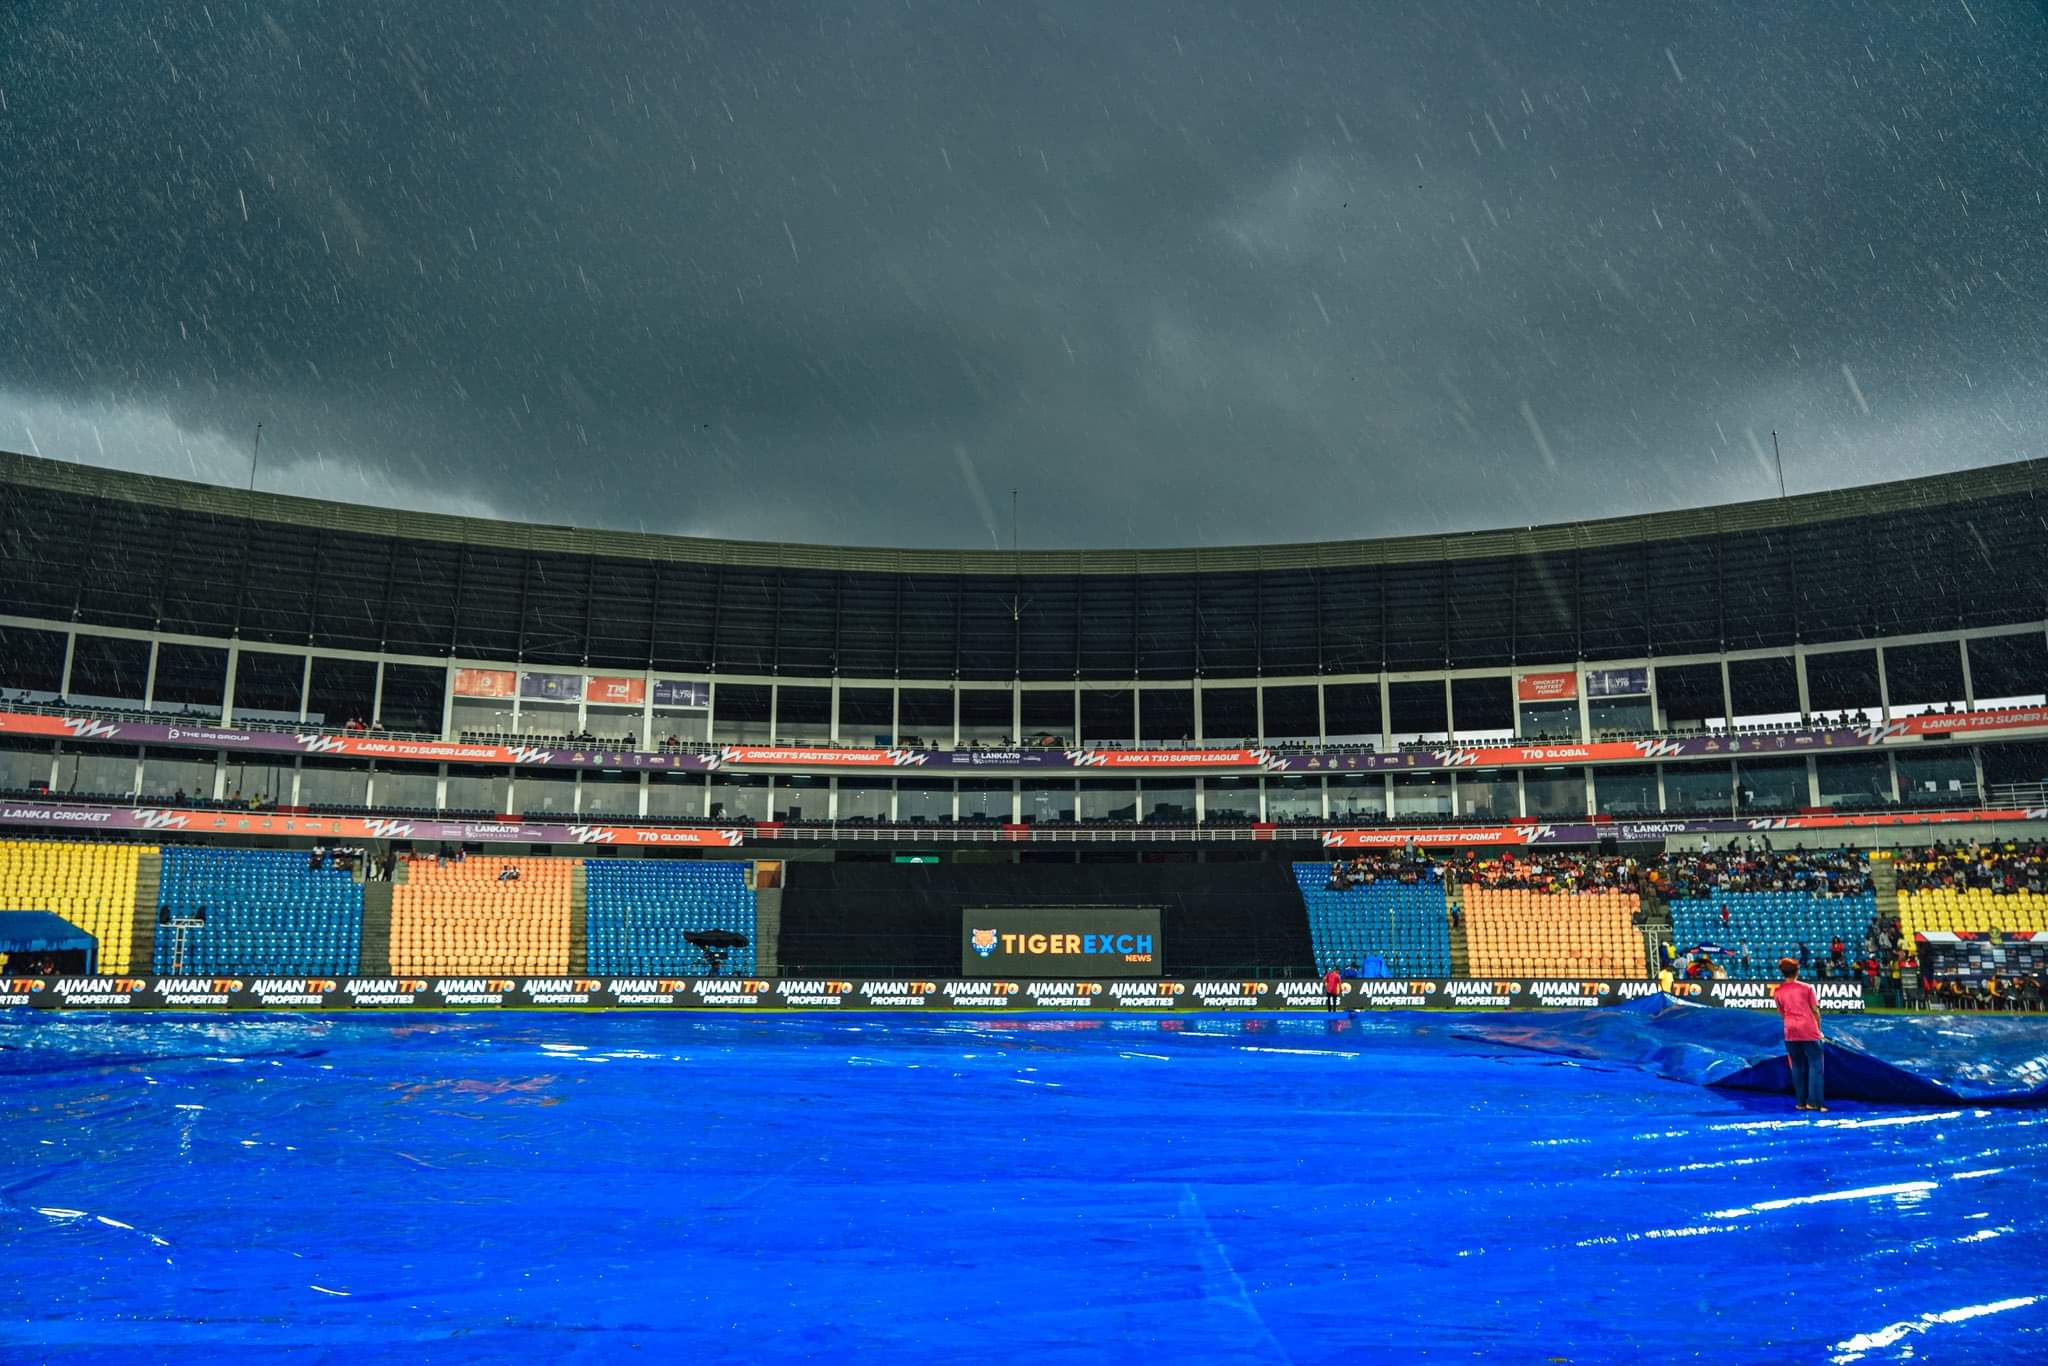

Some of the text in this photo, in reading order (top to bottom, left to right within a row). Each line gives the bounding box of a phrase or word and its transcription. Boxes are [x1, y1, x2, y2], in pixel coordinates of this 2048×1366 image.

[1922, 719, 1966, 728] LANKA
[1970, 717, 1994, 725] T10
[1996, 713, 2040, 723] SUPER
[357, 744, 395, 752] LANKA
[454, 749, 496, 757] LEAGUE
[1522, 749, 1588, 759] T10 GLOBAL
[3, 810, 111, 821] LANKA CRICKET
[637, 832, 658, 841] T10
[1413, 834, 1457, 842] FASTEST
[1002, 934, 1152, 954] TIGEREXCH
[14, 980, 45, 992] T10
[53, 979, 145, 995] AJMAN T10
[154, 980, 243, 996] AJMAN T10
[250, 980, 336, 996] AJMAN T10
[344, 980, 427, 996] AJMAN T10
[435, 980, 515, 996] AJMAN T10
[523, 980, 601, 996] AJMAN T10
[608, 980, 685, 996] AJMAN T10
[693, 981, 769, 997] AJMAN T10
[776, 981, 852, 997] AJMAN T10
[860, 982, 936, 997] AJMAN T10
[943, 983, 1019, 998] AJMAN T10
[1027, 983, 1102, 998] AJMAN T10
[1109, 983, 1184, 998] AJMAN T10
[1193, 983, 1268, 998] AJMAN T10
[1276, 983, 1324, 998] AJMAN
[1360, 982, 1436, 997] AJMAN T10
[1444, 982, 1521, 997] AJMAN T10
[1530, 982, 1609, 997] AJMAN T10
[1673, 983, 1702, 996] T10
[1711, 984, 1765, 999] AJMAN
[1811, 984, 1863, 999] JMAN
[64, 994, 131, 1004] PROPERTIES
[165, 994, 228, 1004] PROPERTIES
[261, 994, 322, 1004] PROPERTIES
[355, 994, 414, 1004] PROPERTIES
[444, 994, 502, 1004] PROPERTIES
[532, 994, 589, 1004] PROPERTIES
[617, 994, 673, 1004] PROPERTIES
[703, 994, 758, 1004] PROPERTIES
[787, 996, 841, 1005] PROPERTIES
[871, 997, 924, 1006] PROPERTIES
[954, 997, 1007, 1006] PROPERTIES
[1037, 998, 1091, 1006] PROPERTIES
[1119, 998, 1174, 1007] PROPERTIES
[1204, 997, 1257, 1006] PROPERTIES
[1370, 997, 1425, 1006] PROPERTIES
[1456, 997, 1510, 1006] PROPERTIES
[1541, 997, 1598, 1007] PROPERTIES
